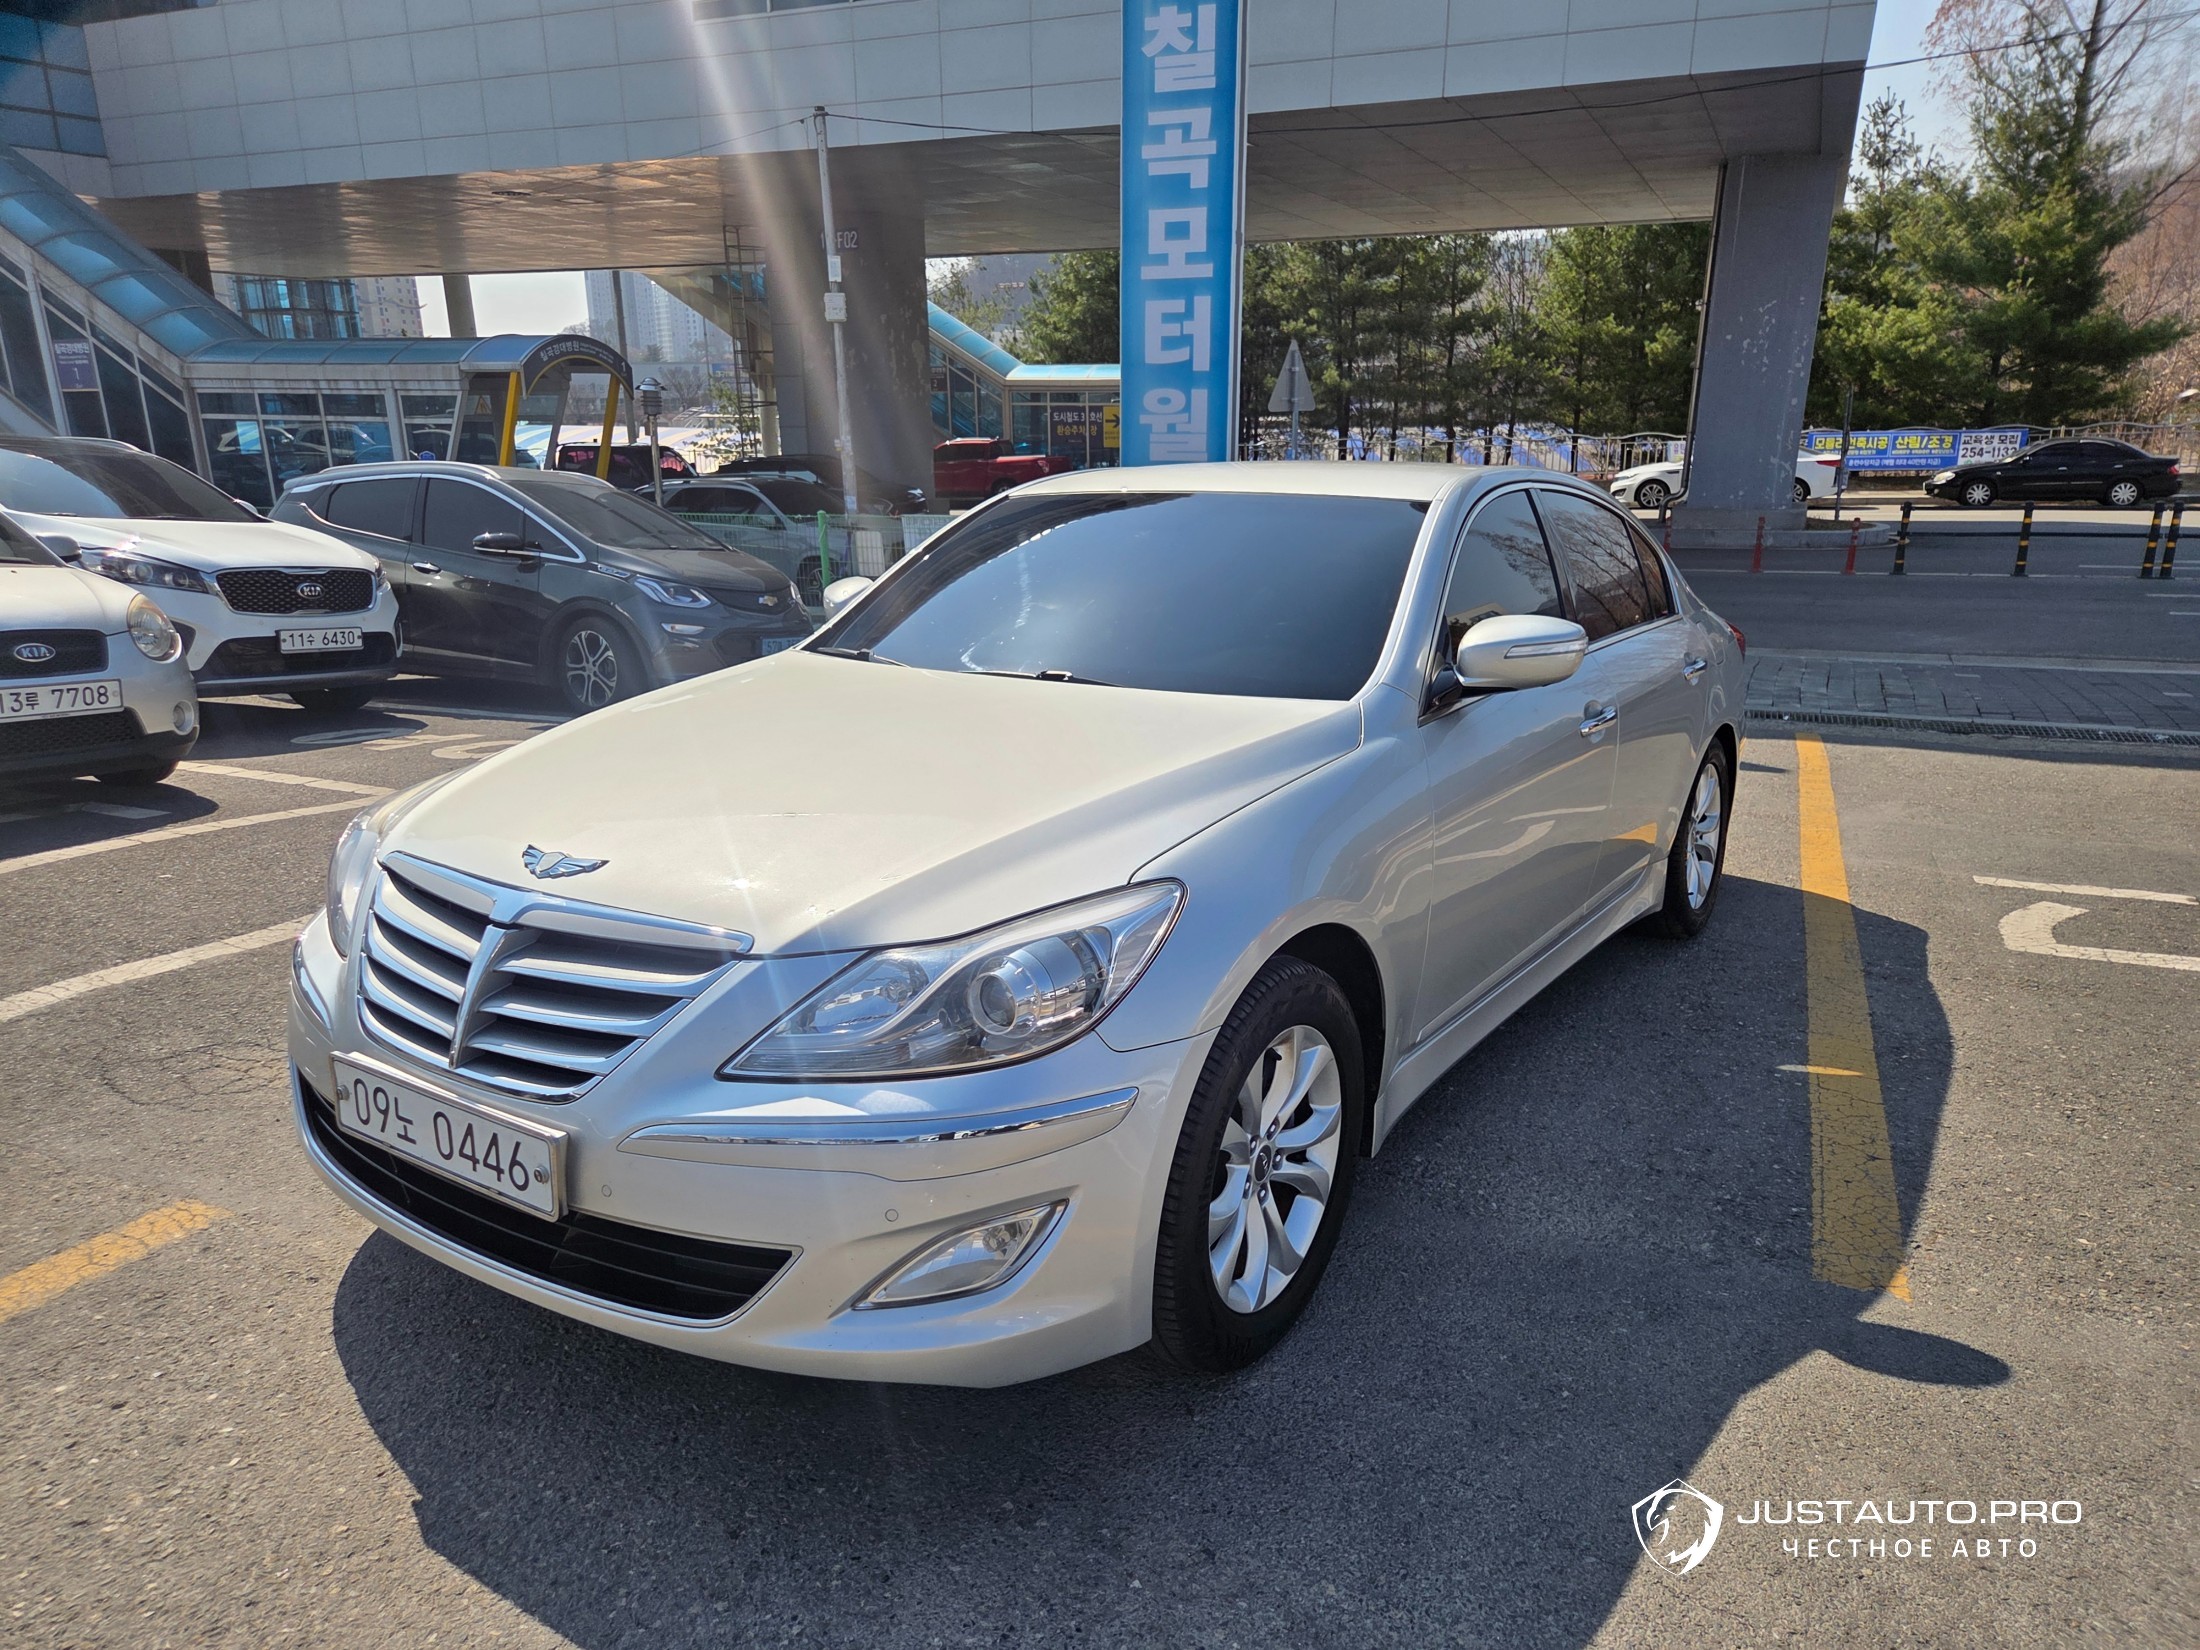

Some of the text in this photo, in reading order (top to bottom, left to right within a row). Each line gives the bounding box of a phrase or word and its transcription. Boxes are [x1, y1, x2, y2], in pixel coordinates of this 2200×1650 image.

[1138, 3, 1218, 462] 칠곡모터월
[1962, 434, 2019, 445] 교육생 모집
[303, 586, 322, 596] KIA
[288, 630, 355, 648] 11수 6430
[20, 646, 50, 658] KIA
[51, 685, 110, 709] 7708
[353, 1077, 530, 1192] 09노 0446
